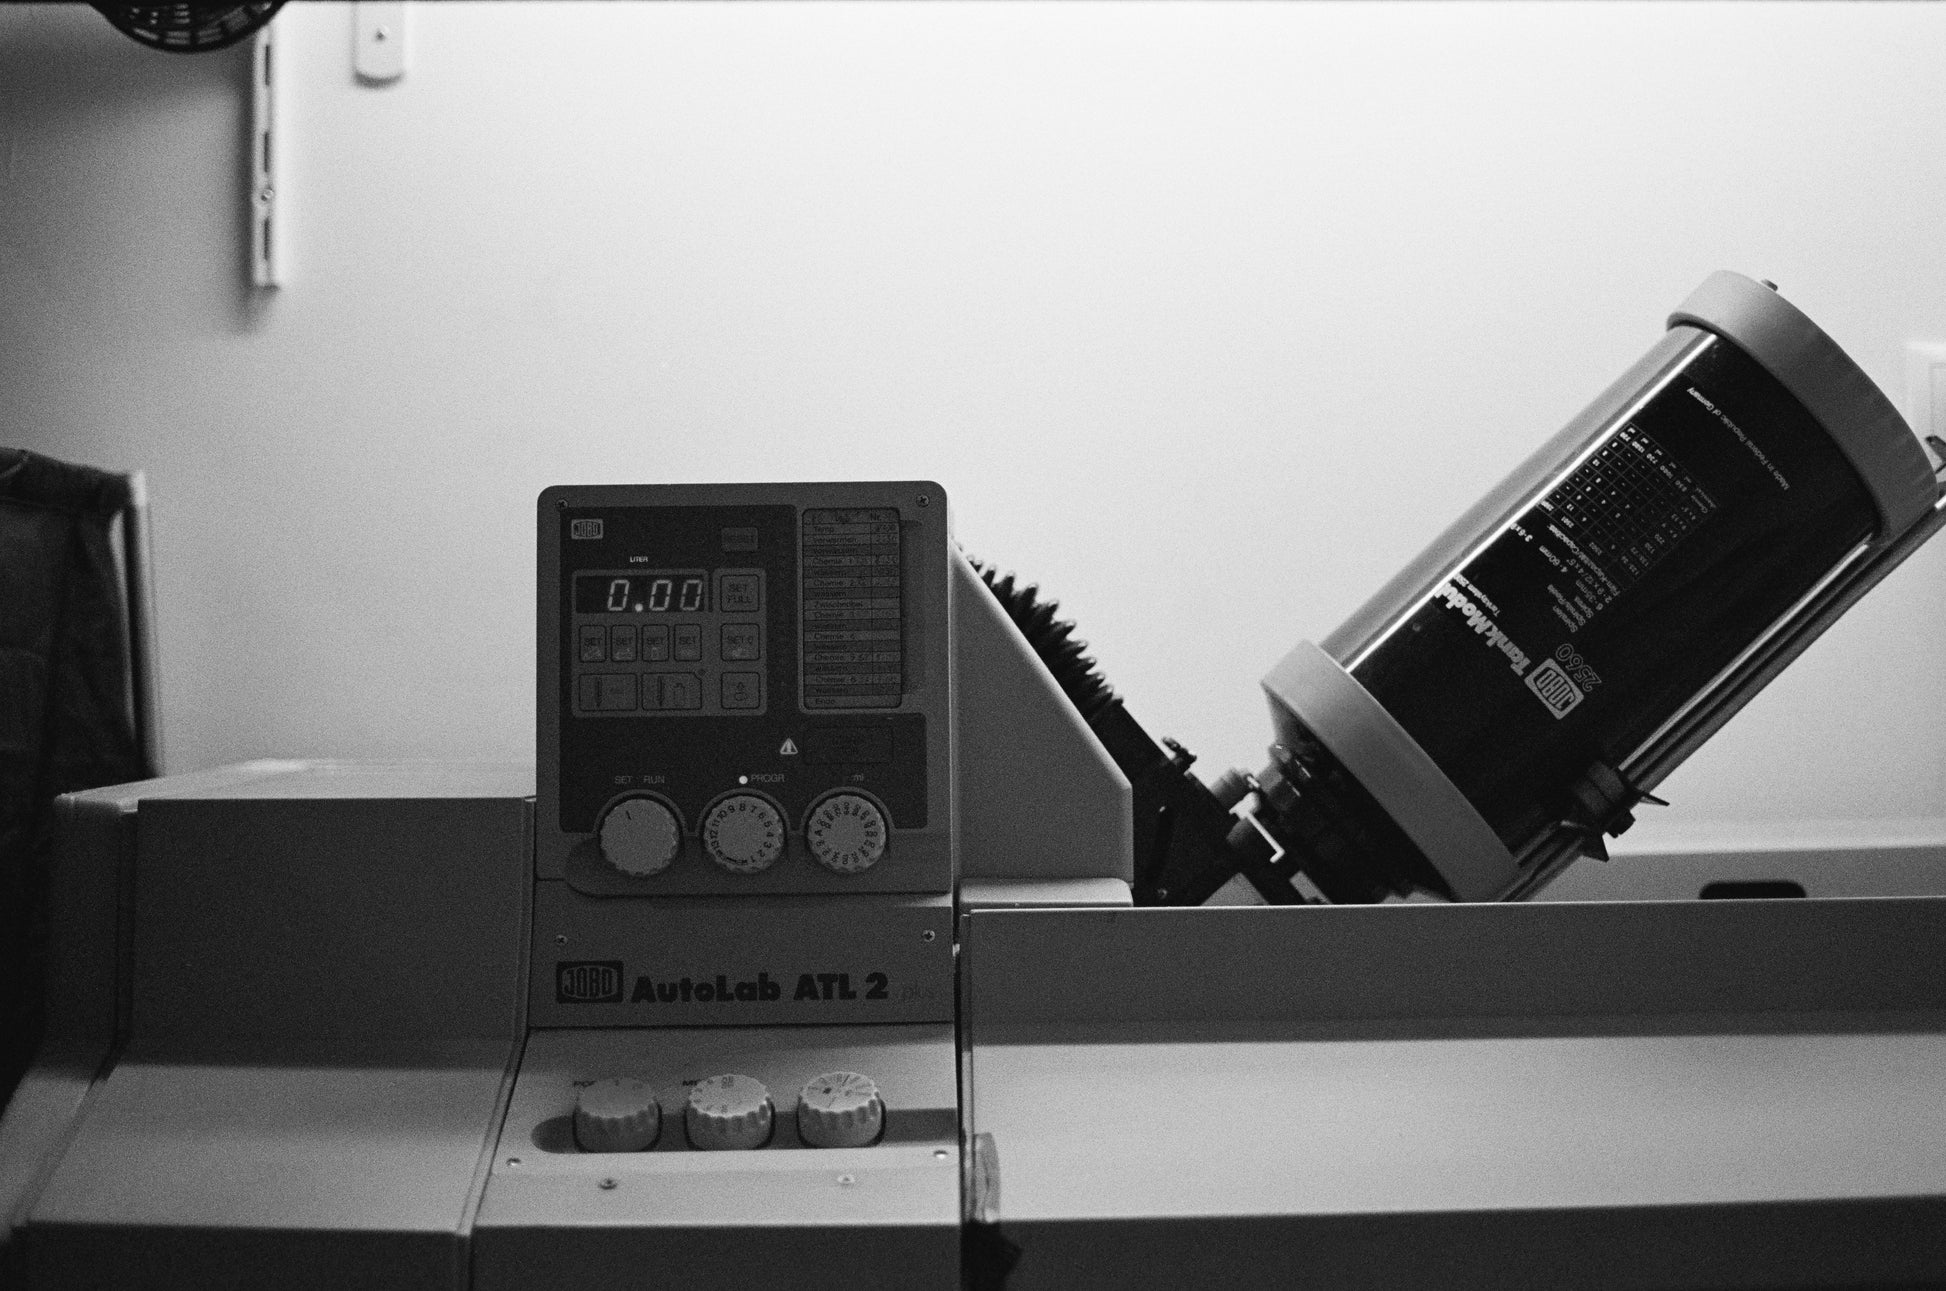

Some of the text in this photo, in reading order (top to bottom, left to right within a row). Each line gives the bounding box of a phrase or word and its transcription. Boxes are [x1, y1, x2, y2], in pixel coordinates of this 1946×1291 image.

[1685, 386, 1790, 491] Made in Federal Republic of Germany
[574, 520, 601, 538] JOBO
[629, 555, 649, 563] LITER
[606, 579, 703, 613] 0.00
[1552, 639, 1602, 693] 2560
[1531, 664, 1579, 712] JOBO
[615, 775, 665, 784] SET RUN
[750, 774, 785, 783] PROGR
[718, 810, 727, 819] 10
[728, 805, 735, 813] 9
[739, 803, 746, 811] 8
[750, 805, 757, 813] 7
[561, 965, 618, 1000] JOBO
[631, 973, 781, 1003] AutoLab
[793, 973, 857, 1001] ATL
[865, 971, 889, 1000] 2
